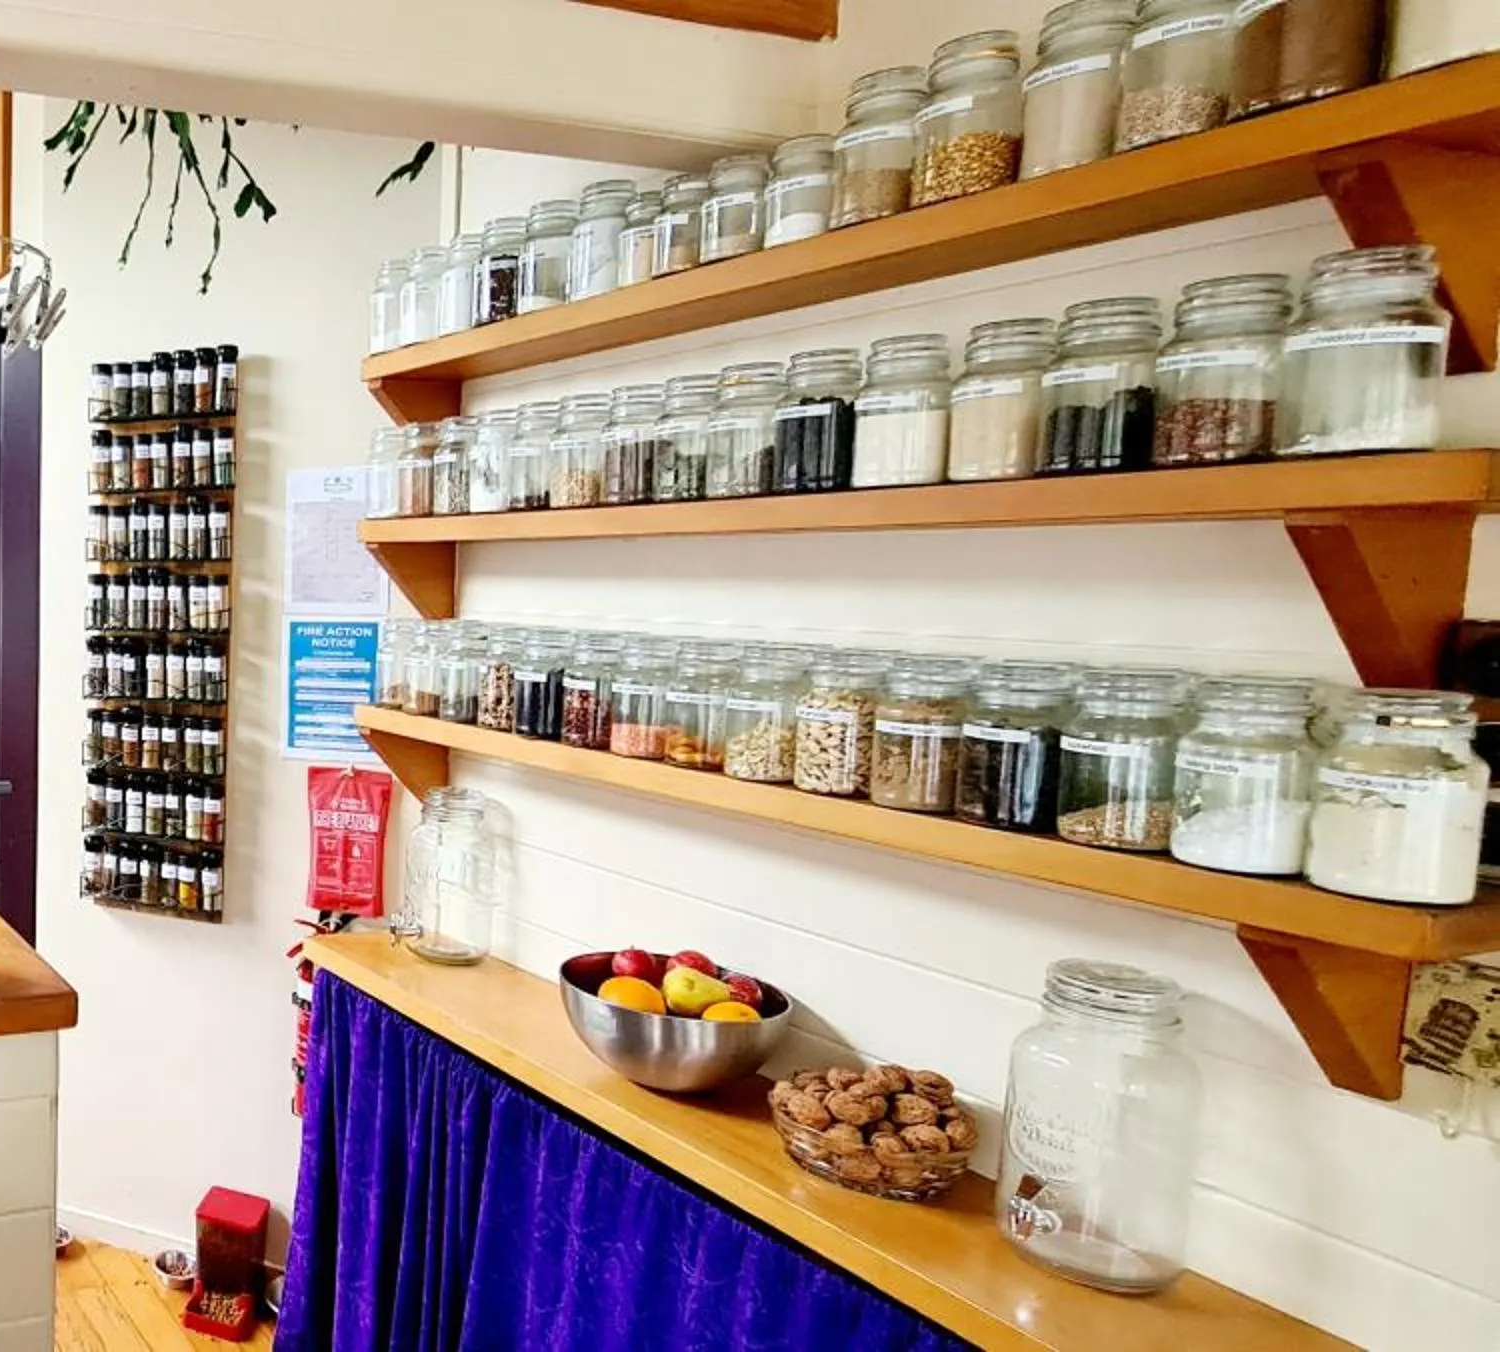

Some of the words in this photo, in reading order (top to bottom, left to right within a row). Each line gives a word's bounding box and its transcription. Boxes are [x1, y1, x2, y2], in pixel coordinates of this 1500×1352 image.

[296, 625, 323, 637] FIRE
[326, 626, 373, 637] ACTION
[311, 637, 357, 649] NOTICE
